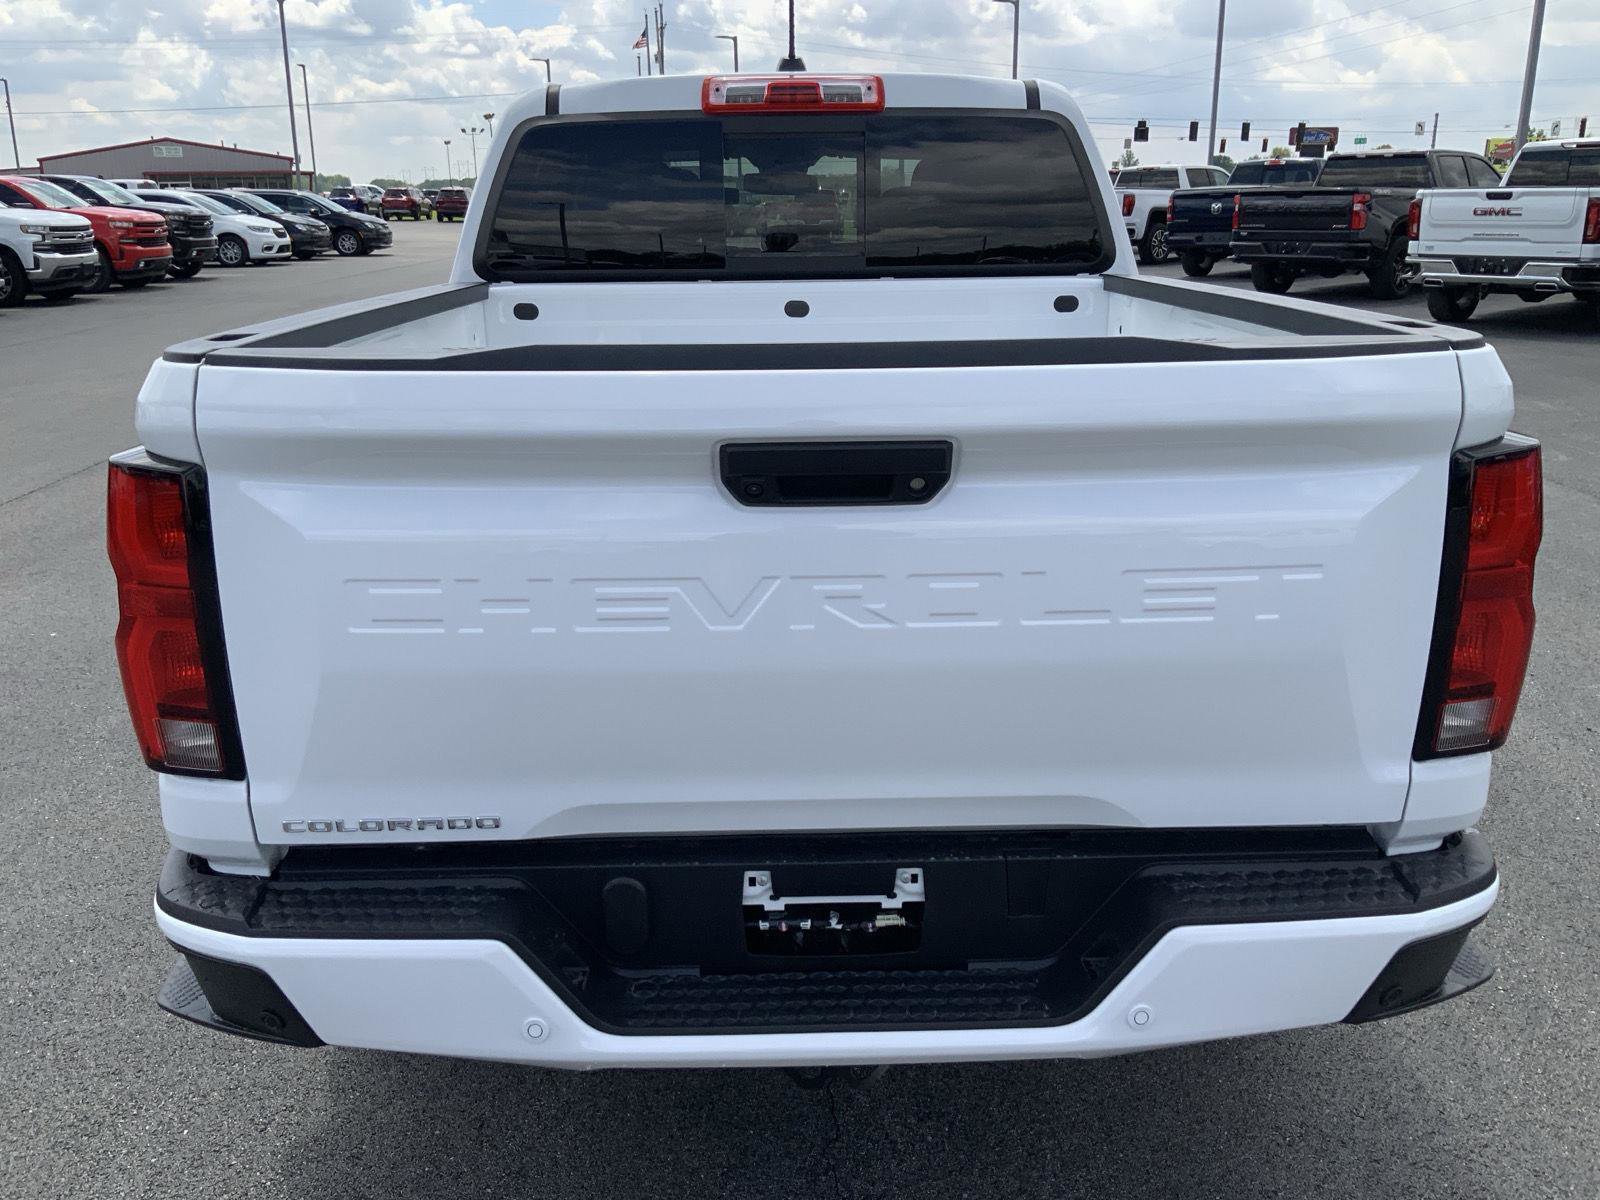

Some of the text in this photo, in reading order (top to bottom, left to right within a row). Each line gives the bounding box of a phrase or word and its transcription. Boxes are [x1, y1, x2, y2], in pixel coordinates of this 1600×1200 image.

[1473, 206, 1523, 217] GMC
[343, 564, 1325, 635] CHEVROLET
[281, 814, 501, 833] COLORADO
